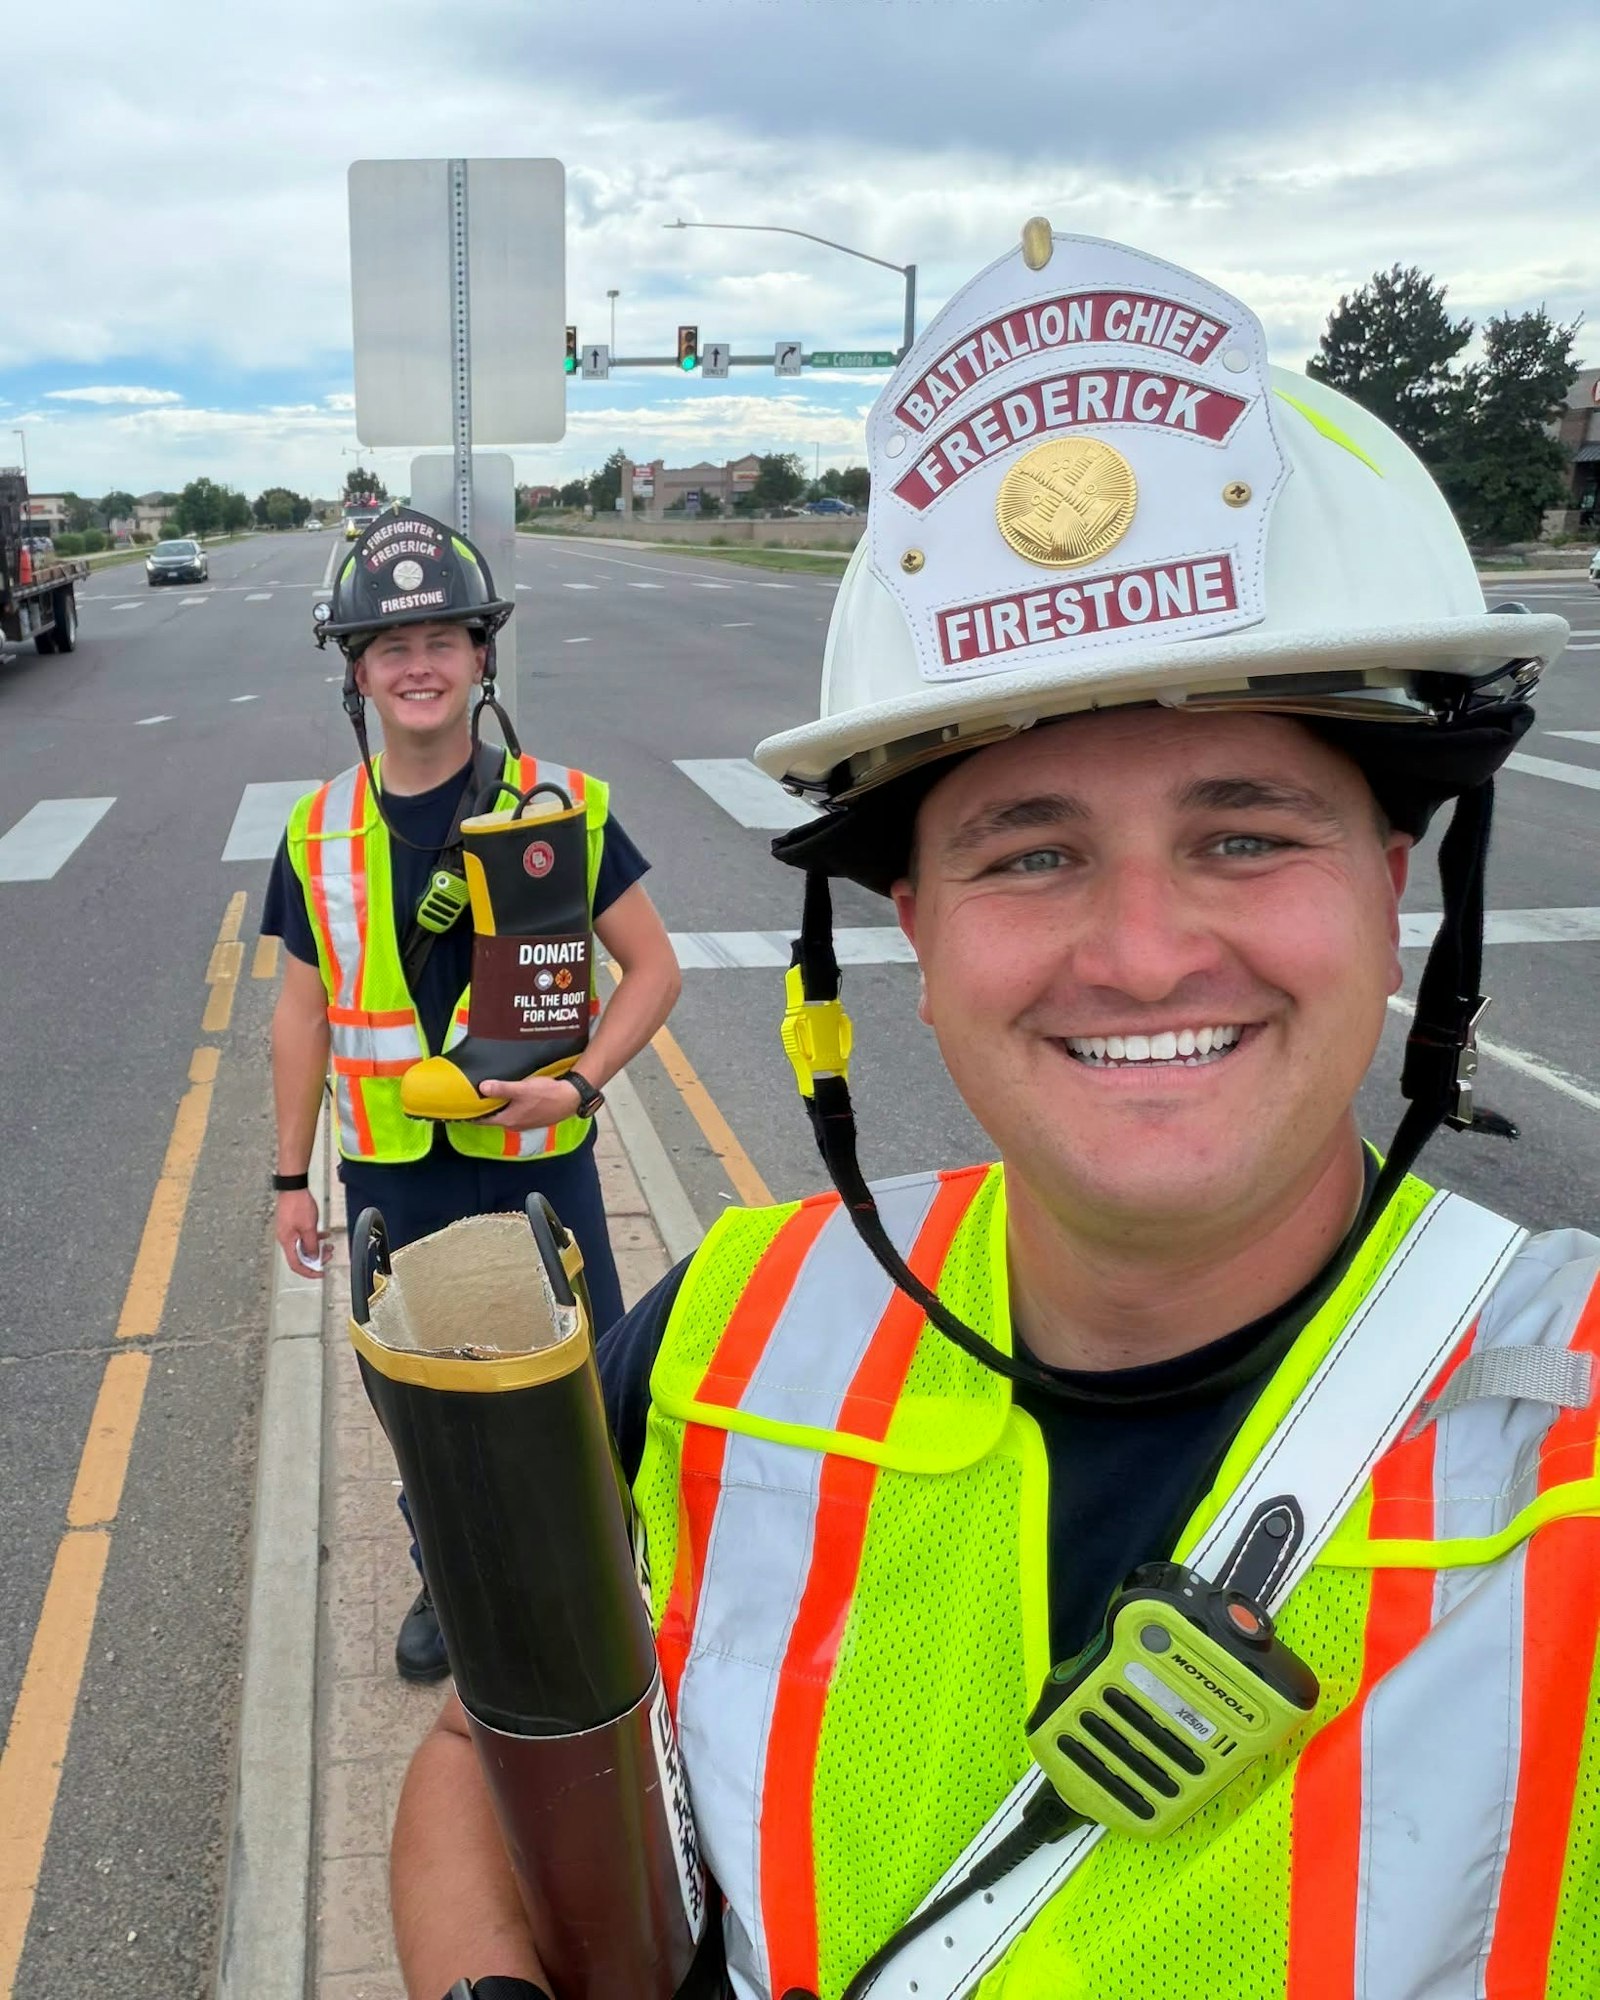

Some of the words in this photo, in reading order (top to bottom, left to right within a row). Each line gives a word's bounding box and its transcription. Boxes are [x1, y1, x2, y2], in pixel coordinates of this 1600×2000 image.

[833, 352, 874, 367] Colorado
[906, 301, 1093, 429] BATTALION
[1103, 300, 1219, 356] CHIEF
[916, 375, 1212, 494] FREDERICK
[366, 521, 435, 550] FIREFIGHTER
[371, 540, 438, 567] FREDERICK
[381, 590, 444, 613] FIRESTONE
[945, 561, 1228, 661] FIRESTONE
[519, 941, 585, 965] DONATE
[514, 995, 537, 1008] FILL
[540, 994, 560, 1007] THE
[562, 991, 585, 1005] BOOT
[523, 1009, 545, 1023] FOR
[548, 1008, 579, 1021] MDA
[1171, 1653, 1255, 1723] MOTOROLA
[1175, 1708, 1209, 1735] XE500
